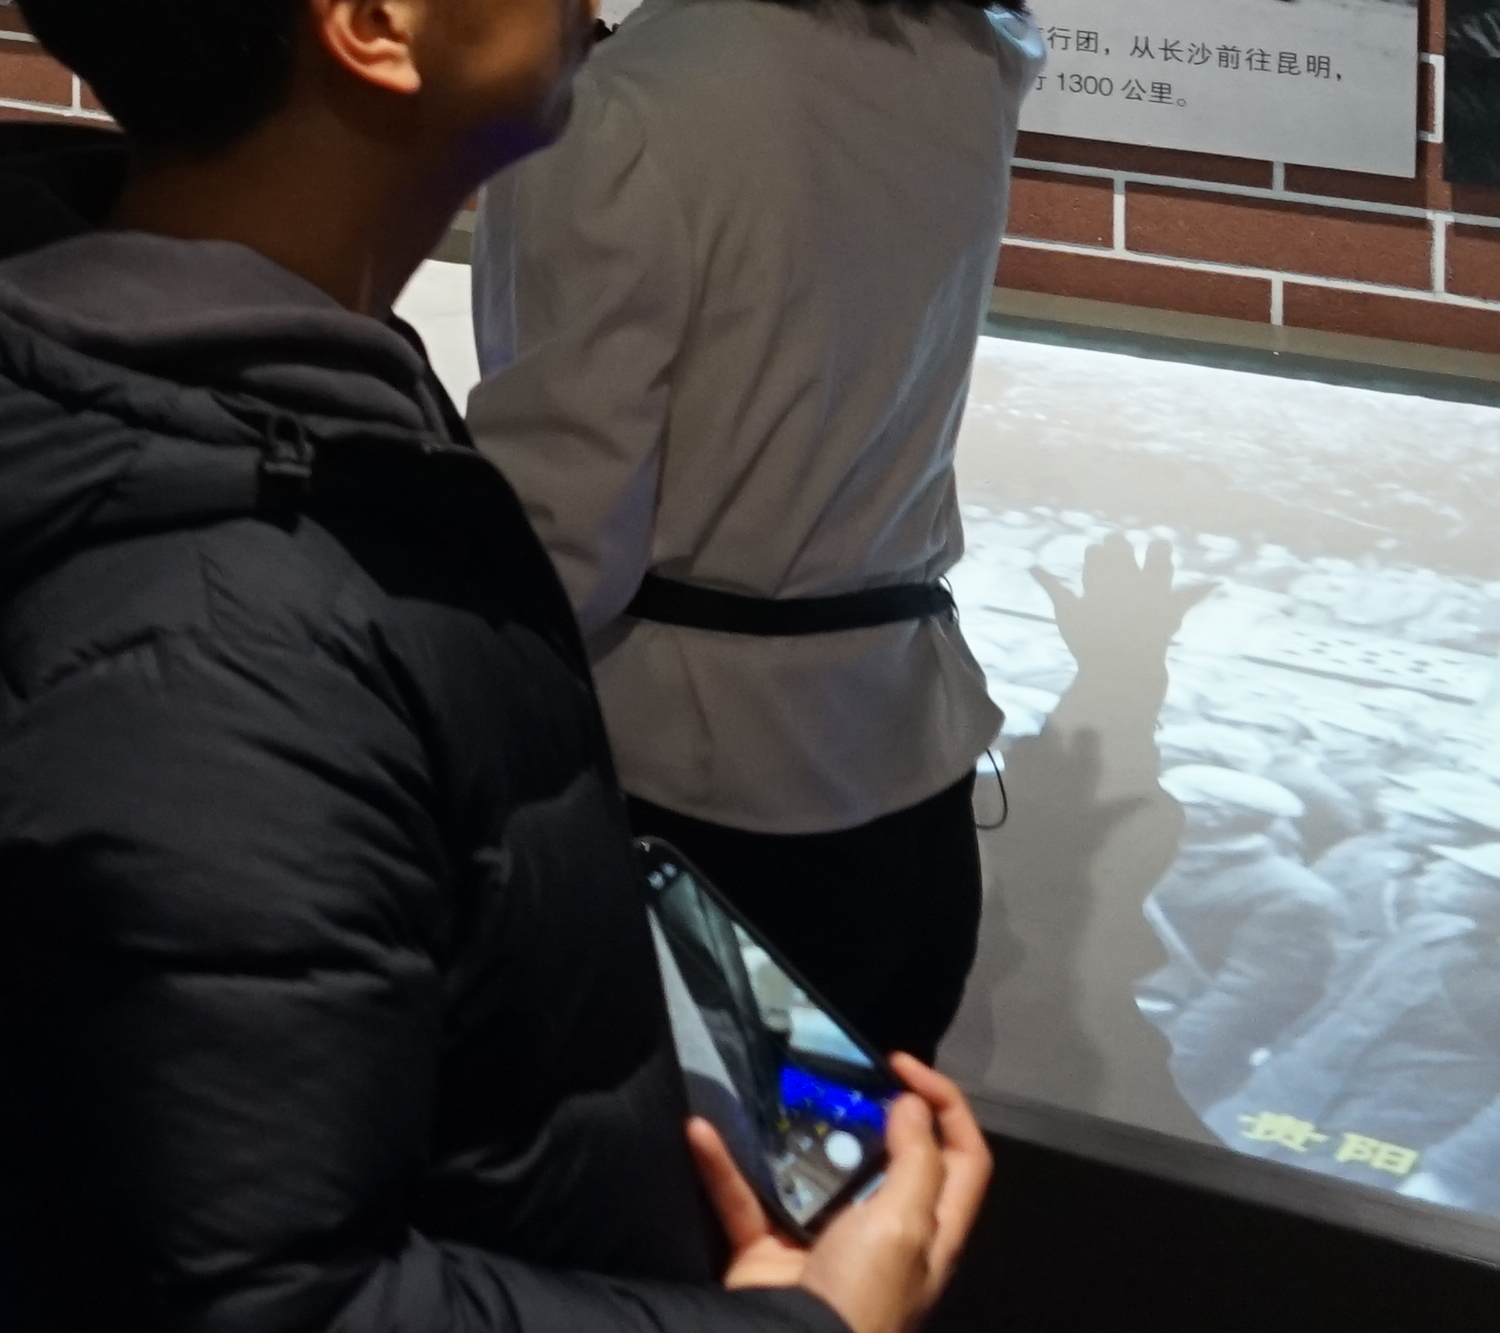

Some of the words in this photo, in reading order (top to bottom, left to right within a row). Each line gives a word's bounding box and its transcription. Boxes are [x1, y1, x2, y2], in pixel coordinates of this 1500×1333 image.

[1040, 26, 1342, 82] 行团，从长沙前往昆明，
